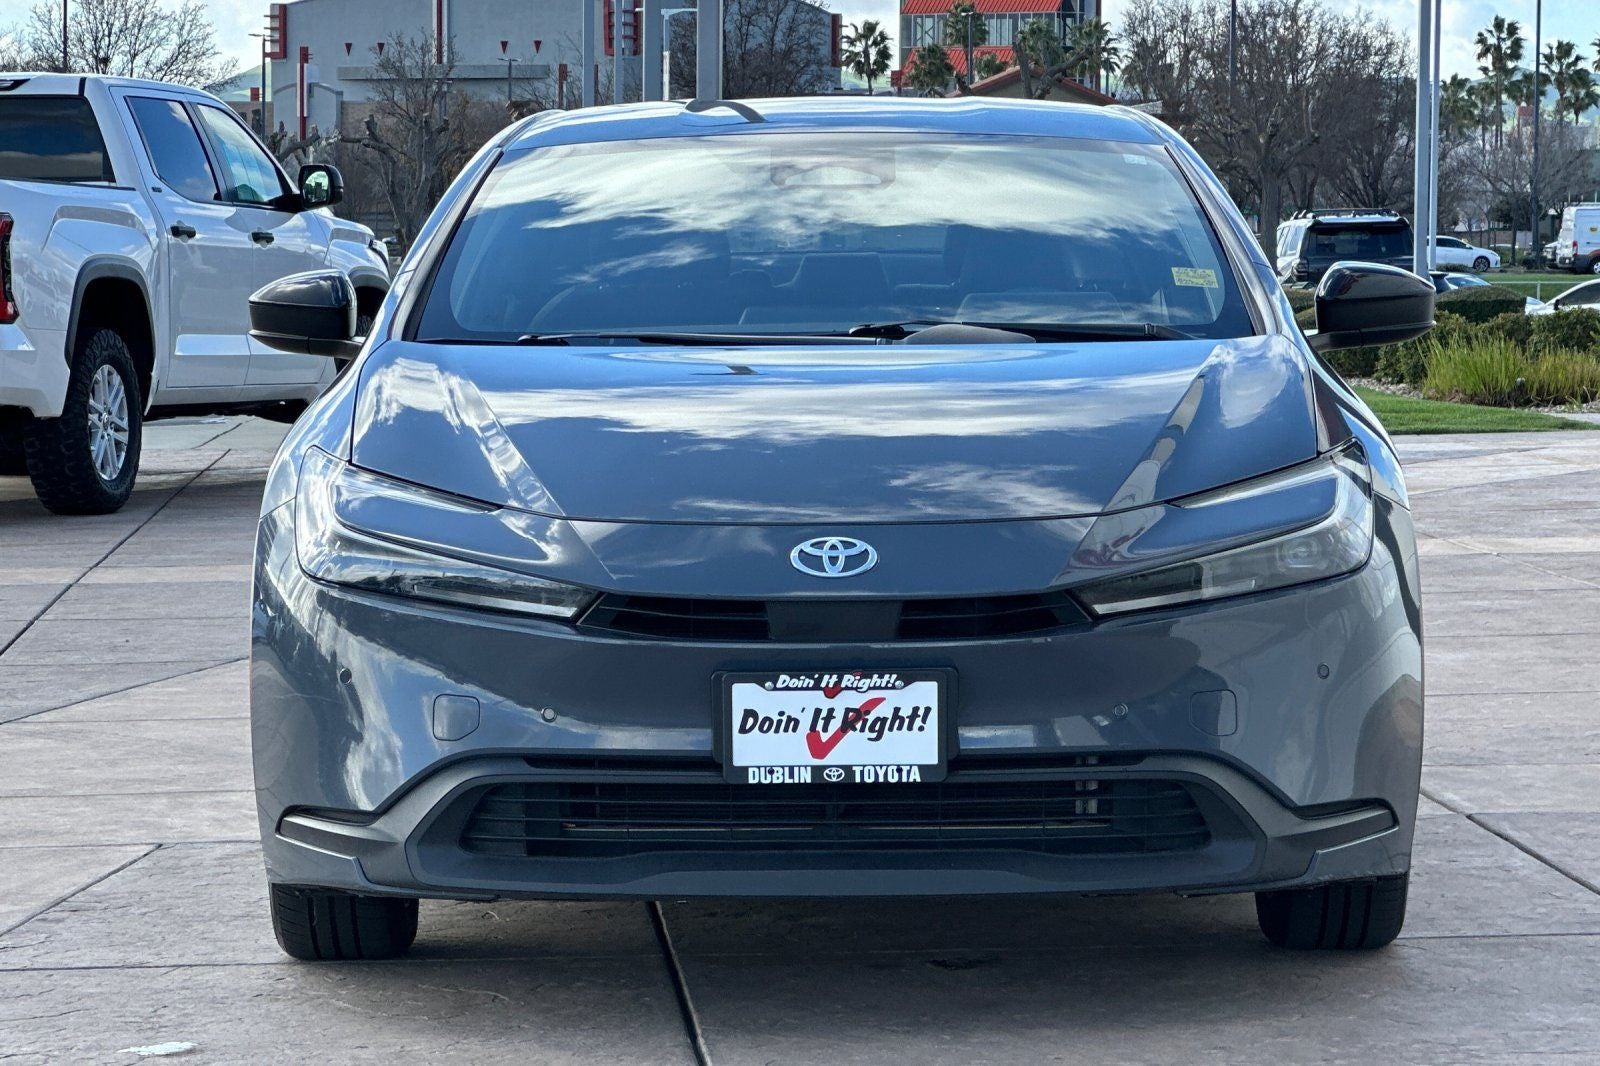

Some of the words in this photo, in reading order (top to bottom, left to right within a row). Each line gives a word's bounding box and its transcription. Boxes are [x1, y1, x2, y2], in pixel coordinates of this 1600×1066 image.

[776, 674, 818, 689] Doin'
[822, 674, 838, 688] It
[841, 673, 898, 692] Right!
[738, 707, 805, 734] Doin'
[809, 707, 836, 733] It
[841, 706, 932, 742] Right!
[748, 767, 811, 784] DUBLIN
[852, 766, 921, 783] TOYOTA
